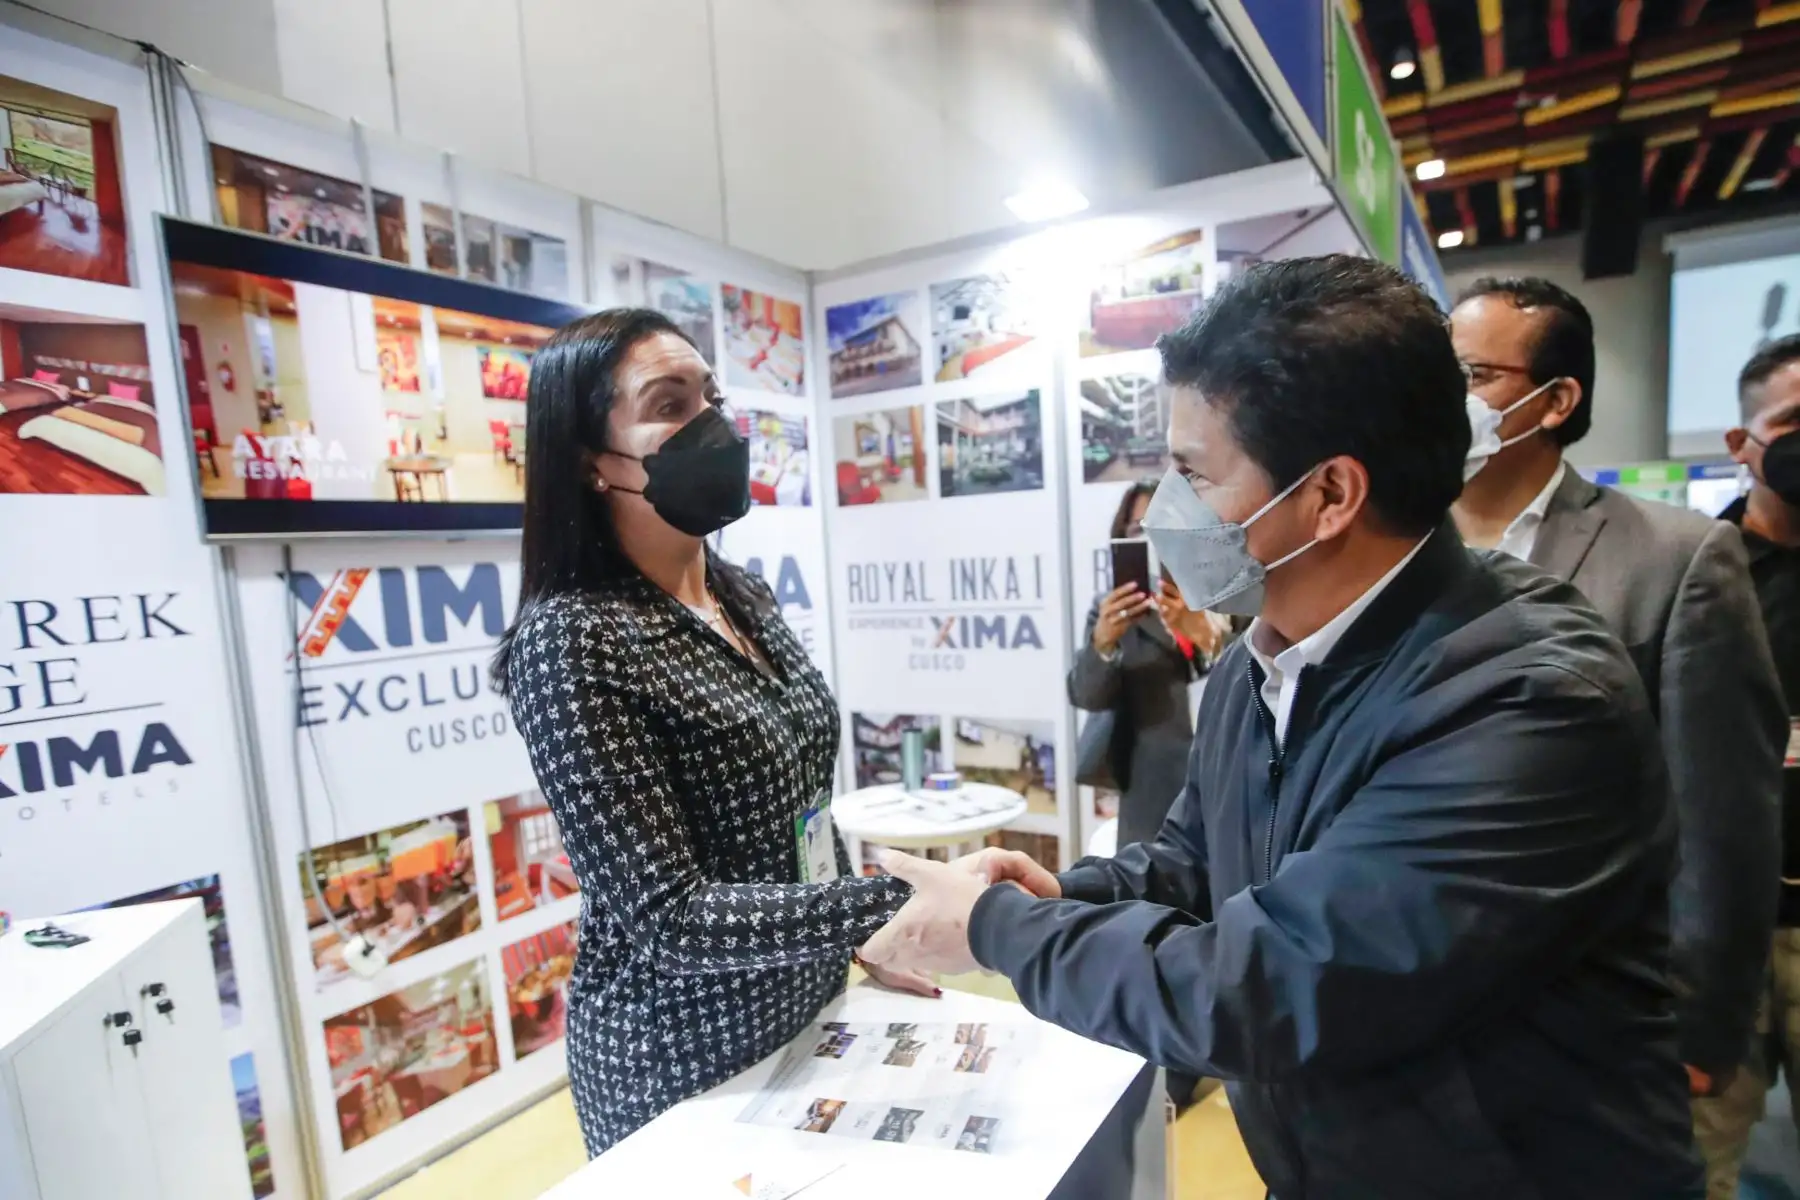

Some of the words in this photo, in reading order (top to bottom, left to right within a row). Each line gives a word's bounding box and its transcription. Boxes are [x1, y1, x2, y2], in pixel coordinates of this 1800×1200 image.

[848, 562, 934, 603] ROYAL
[951, 557, 1021, 601] INKA
[6, 592, 193, 650] REK
[277, 563, 505, 661] XIM
[930, 614, 1044, 649] XIMA
[406, 713, 507, 754] CUSCO
[18, 779, 179, 820] OTELS
